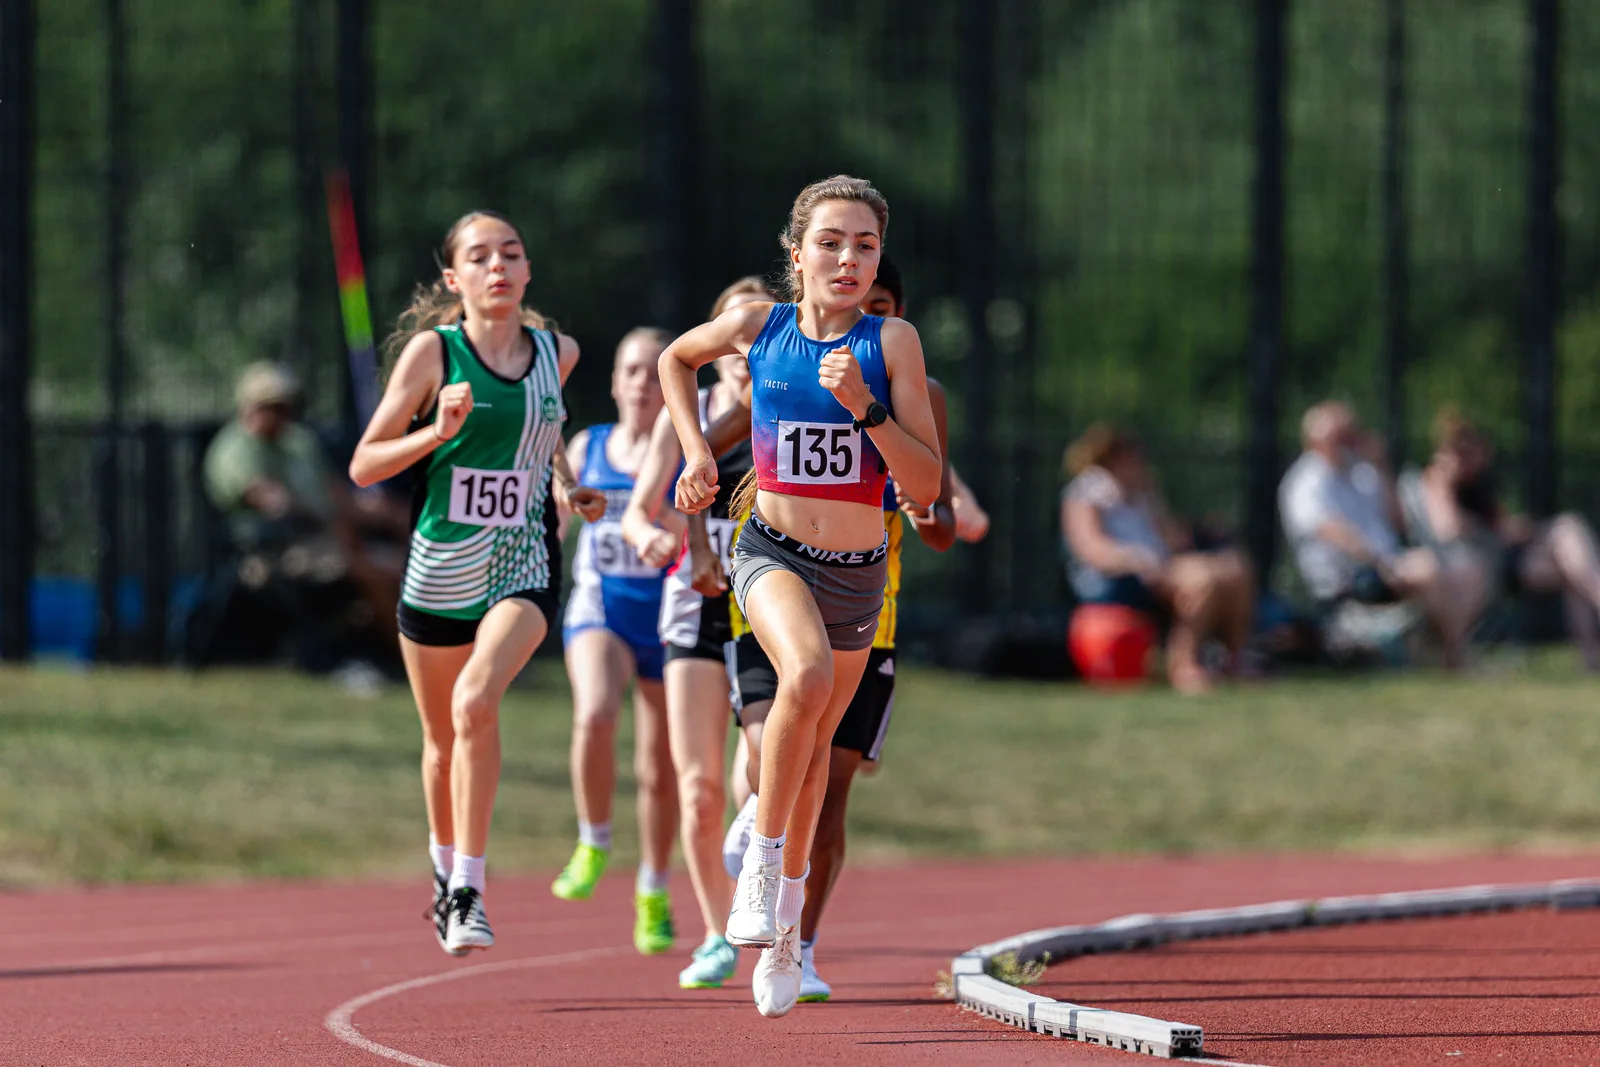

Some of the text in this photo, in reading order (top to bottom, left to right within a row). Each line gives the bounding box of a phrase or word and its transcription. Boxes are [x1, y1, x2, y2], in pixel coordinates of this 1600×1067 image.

[764, 379, 788, 391] TACTIC
[785, 427, 853, 478] 135
[460, 475, 519, 518] 156
[796, 543, 867, 564] NIKE
